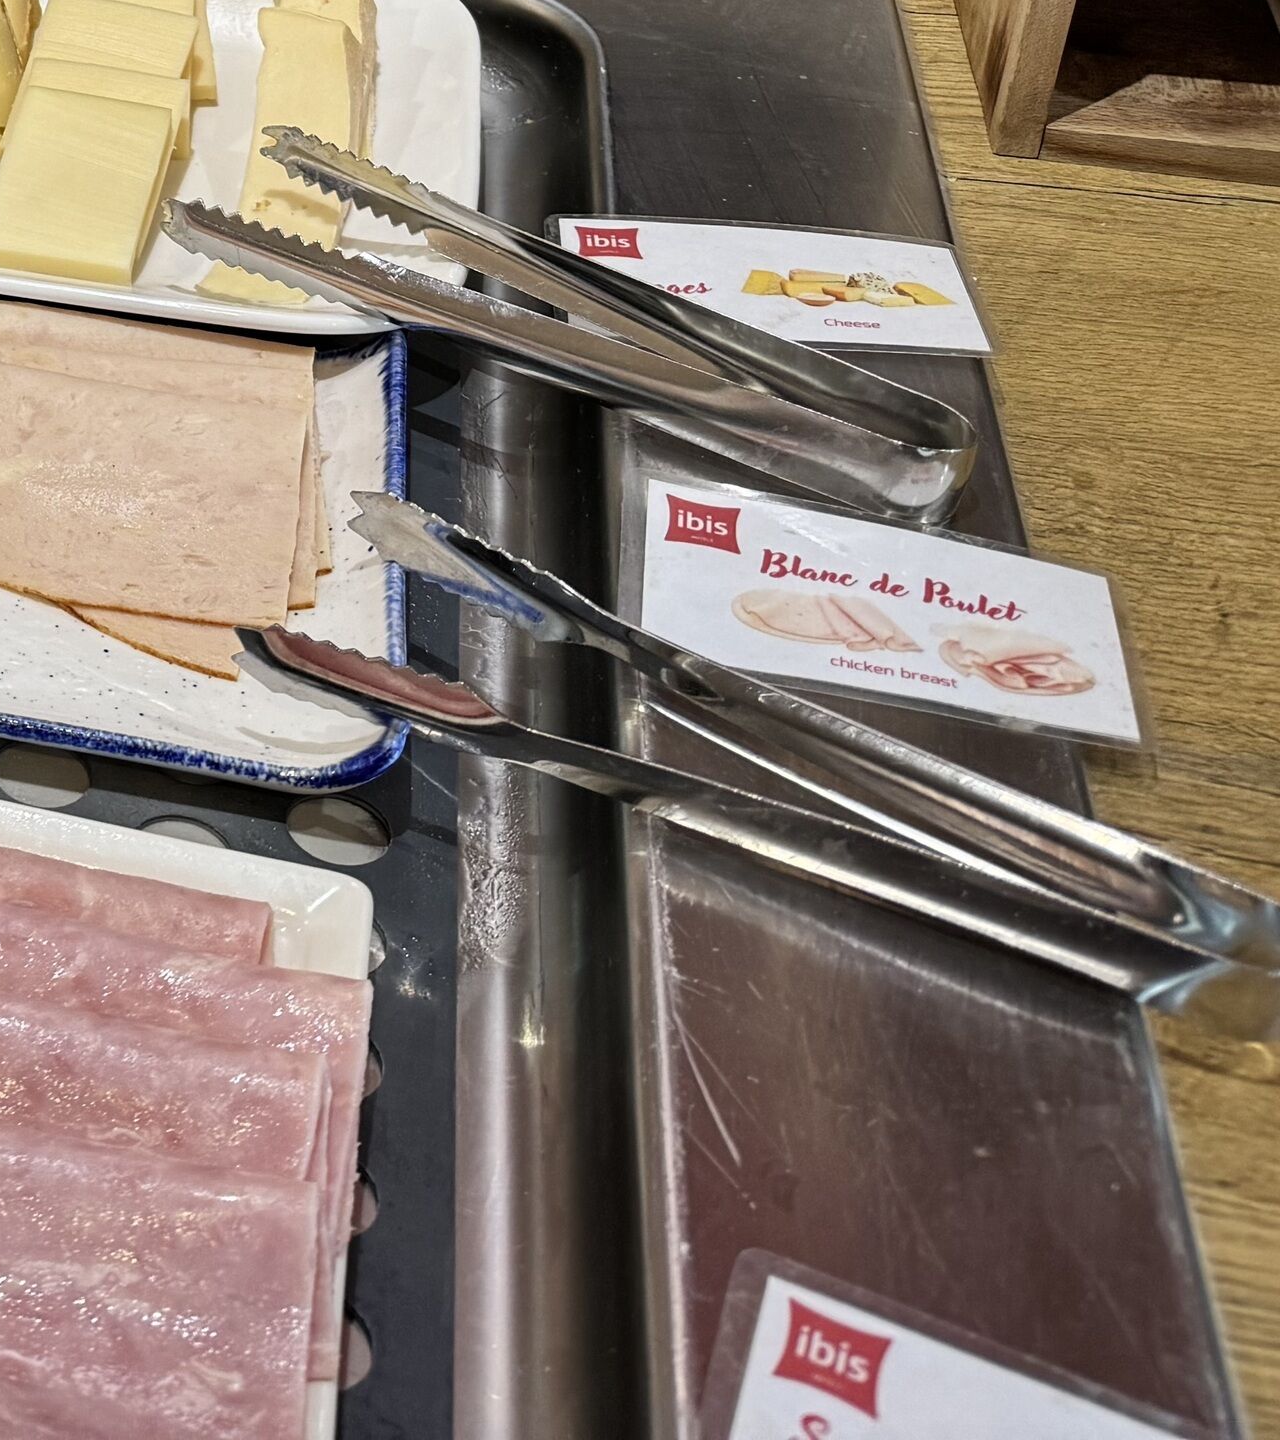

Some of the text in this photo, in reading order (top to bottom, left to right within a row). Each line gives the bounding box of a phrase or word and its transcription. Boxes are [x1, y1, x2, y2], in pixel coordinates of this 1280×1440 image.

[585, 234, 632, 249] ibis
[823, 318, 881, 329] Cheese
[677, 509, 729, 536] ibis
[759, 547, 1028, 624] Blanc de Poulet
[830, 656, 959, 689] chicken breast
[794, 1324, 871, 1385] ibis
